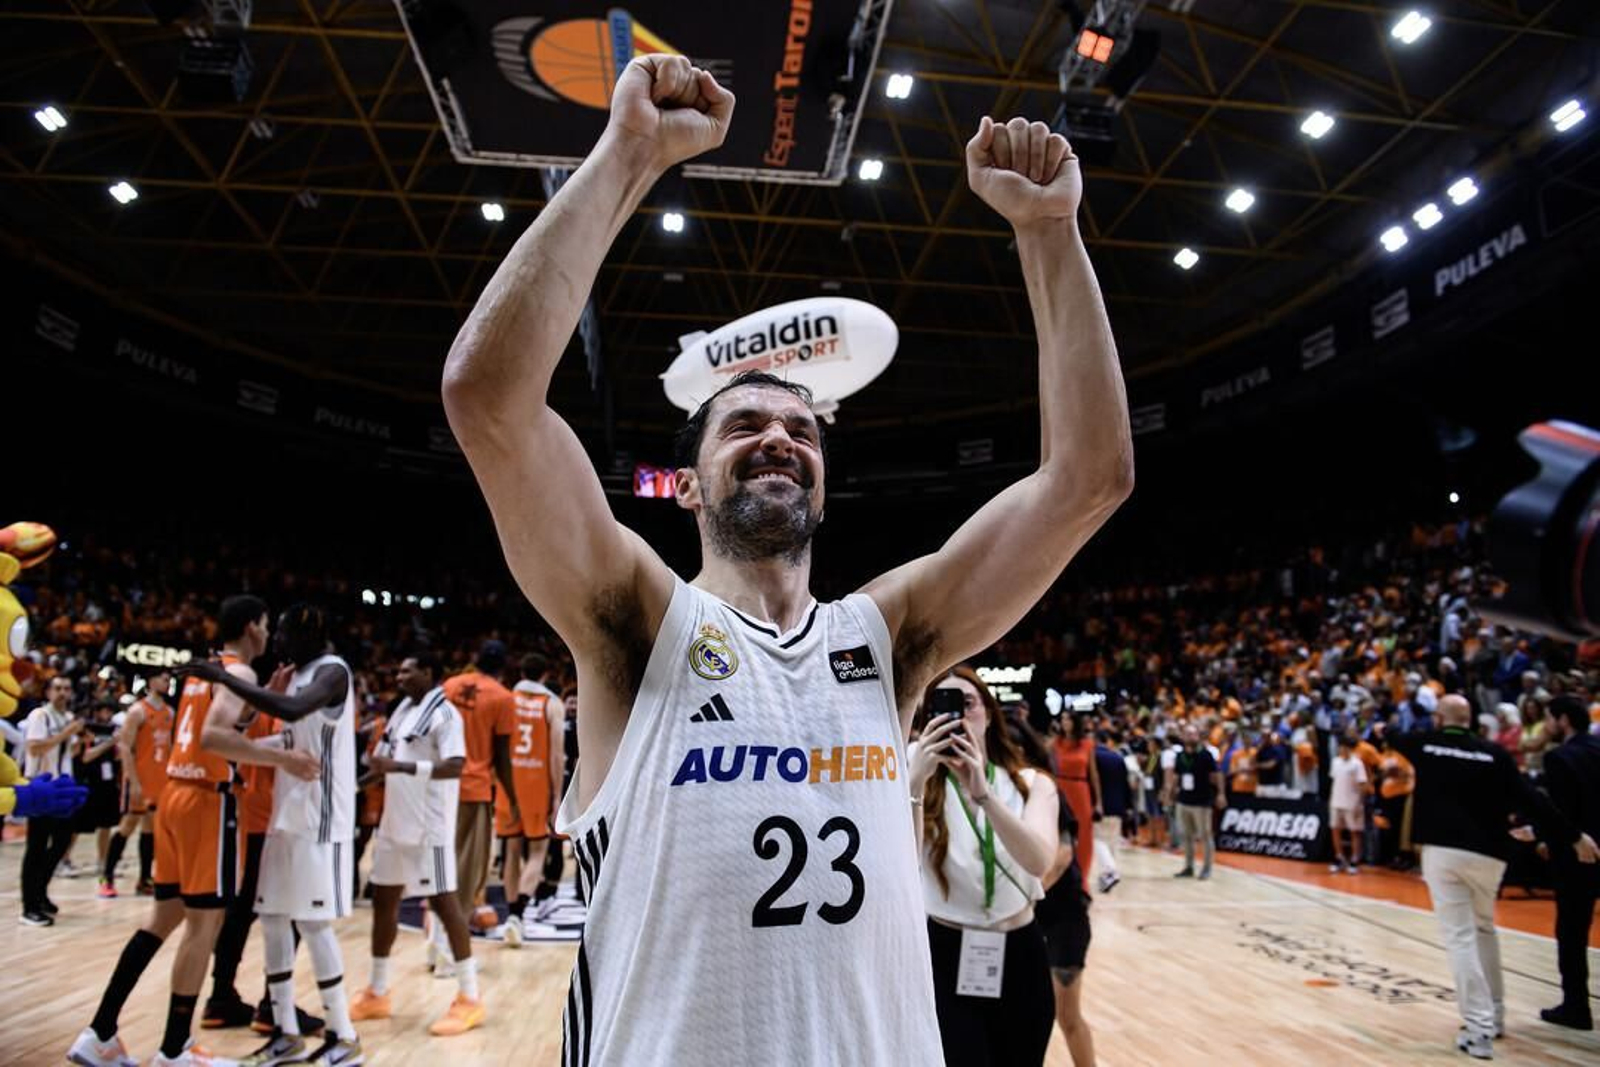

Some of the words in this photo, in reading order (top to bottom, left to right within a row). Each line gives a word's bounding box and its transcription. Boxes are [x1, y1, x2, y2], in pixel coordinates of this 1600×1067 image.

[1435, 224, 1527, 297] PULEVA
[114, 337, 197, 382] PULEVA
[706, 313, 838, 368] Vitaldin
[772, 338, 838, 369] SPORT
[176, 703, 194, 752] 4
[515, 724, 533, 754] 3
[670, 745, 898, 786] AUTOHERO
[1220, 808, 1320, 840] PAMESA
[752, 815, 866, 928] 23
